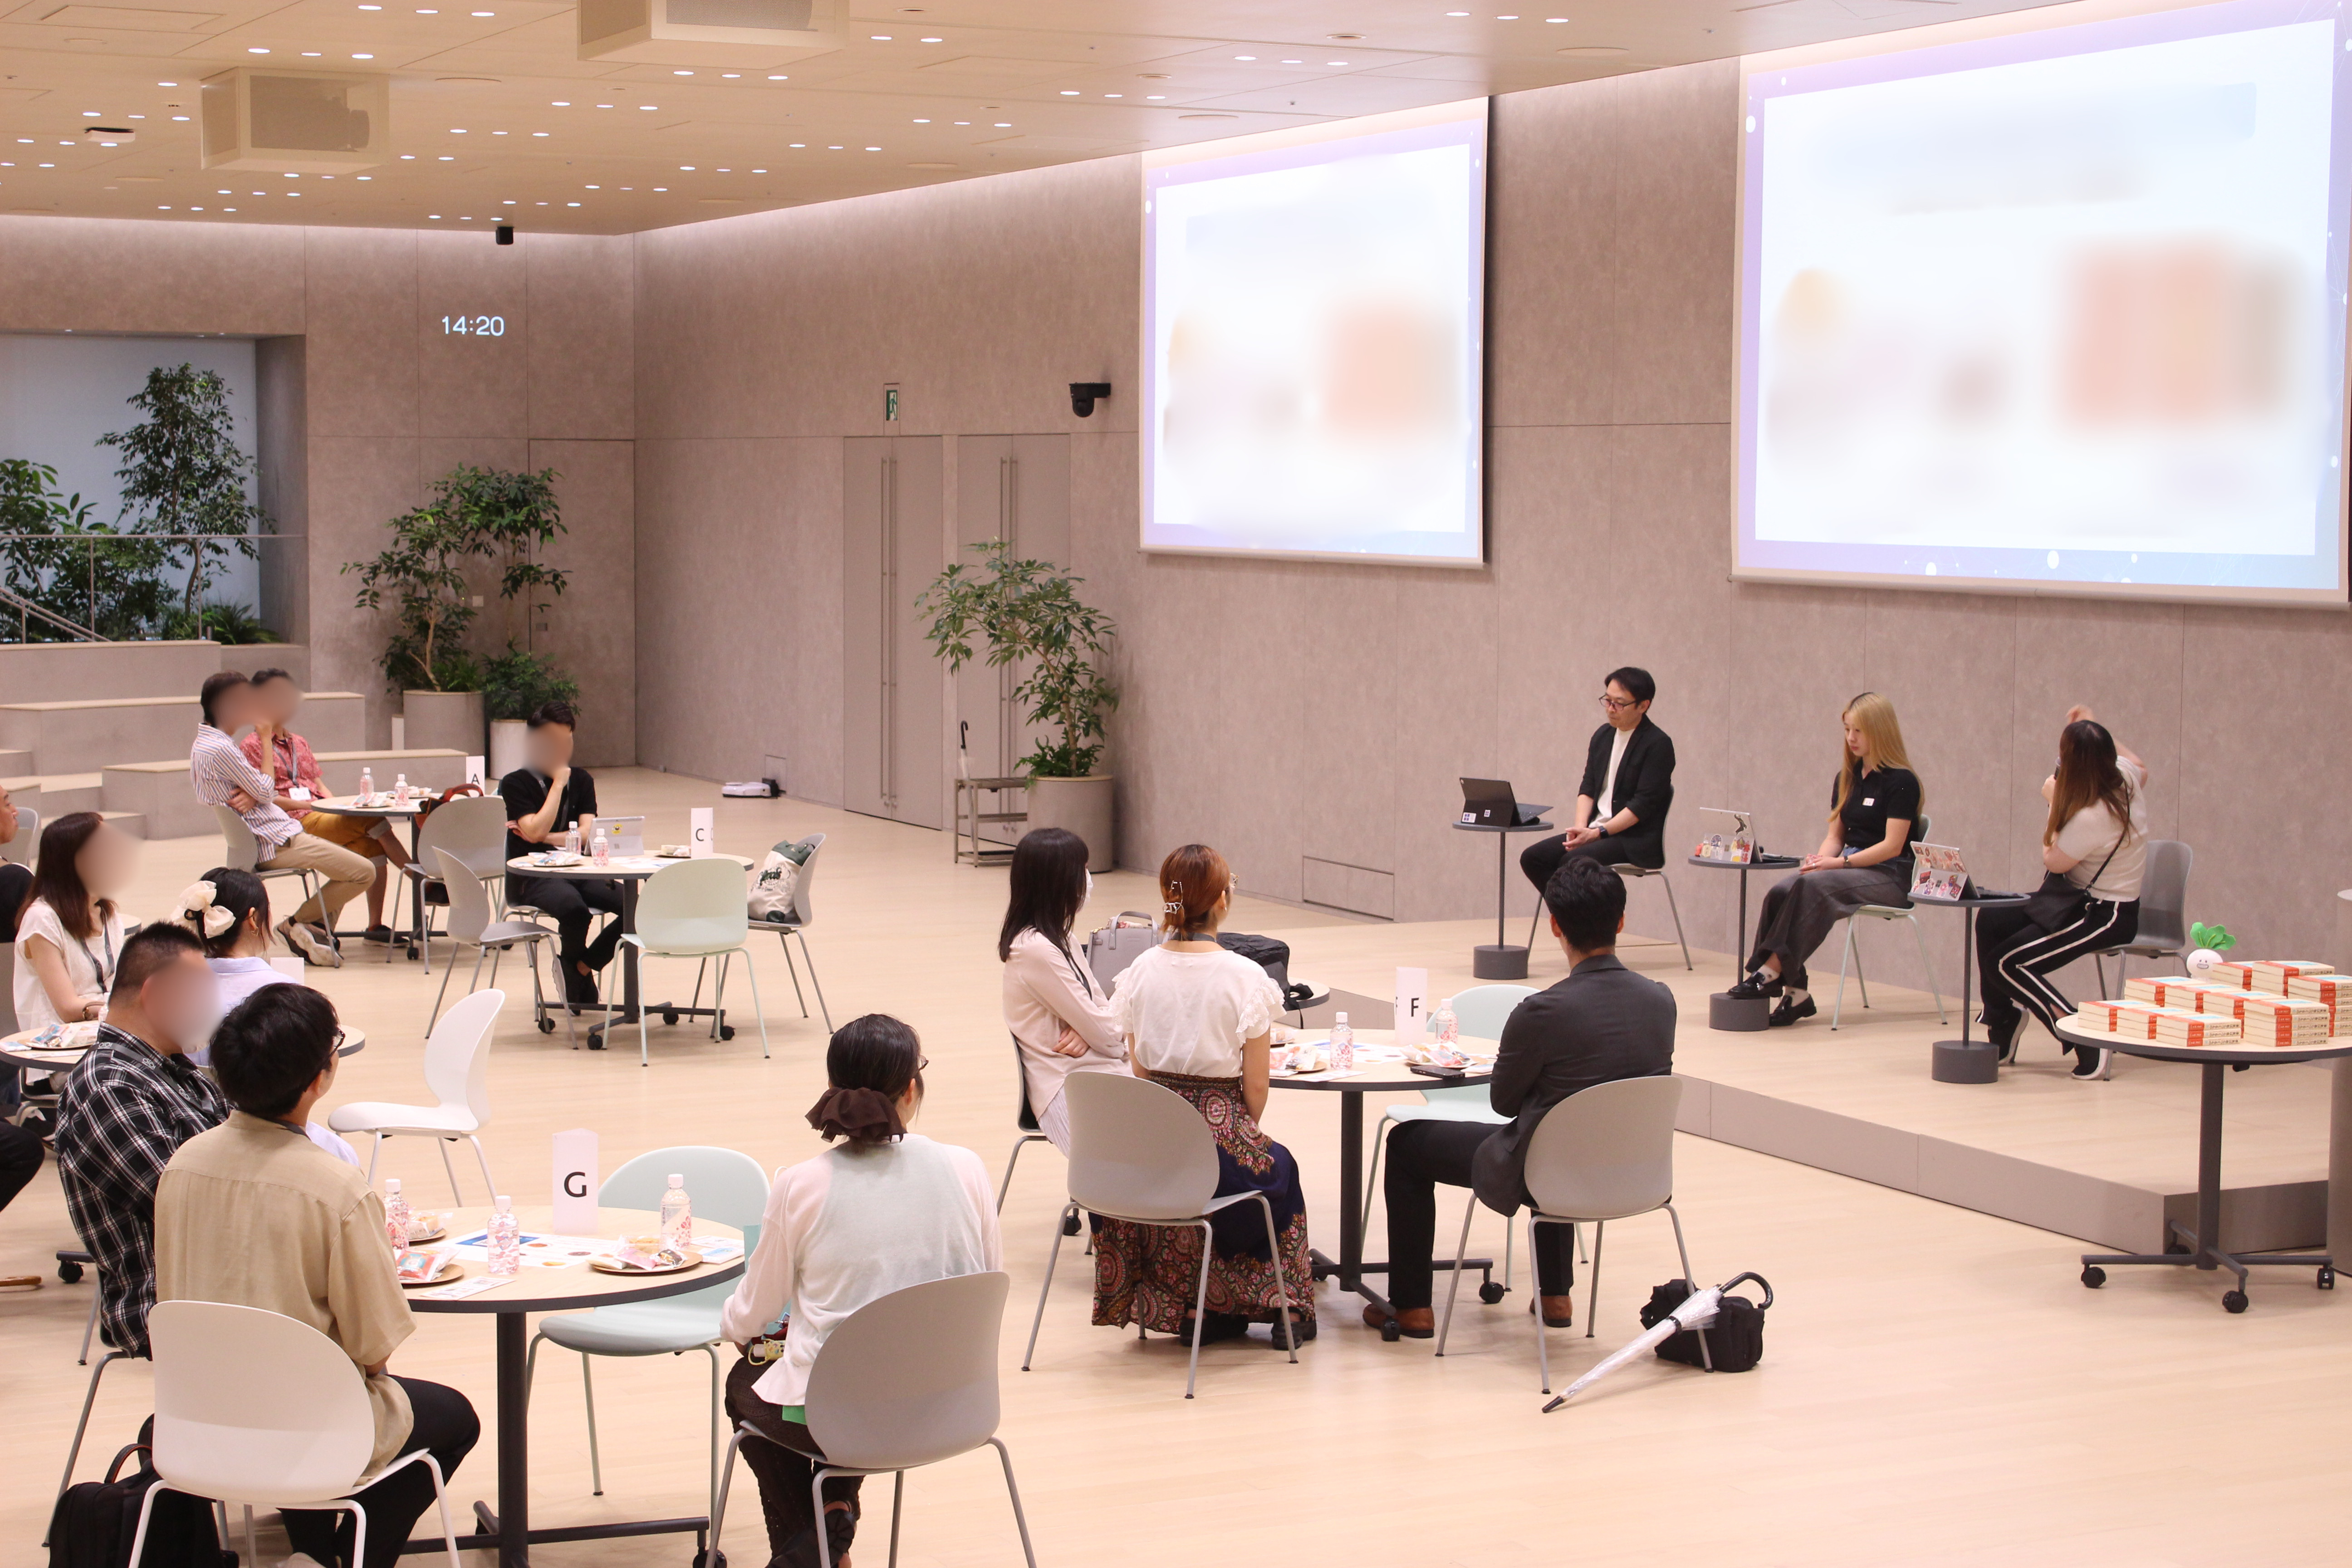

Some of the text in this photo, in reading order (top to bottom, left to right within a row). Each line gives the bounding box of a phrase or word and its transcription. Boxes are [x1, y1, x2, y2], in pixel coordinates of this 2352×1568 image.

[442, 316, 505, 336] 14:20
[471, 773, 480, 784] A
[696, 828, 704, 842] C
[1411, 997, 1419, 1017] F
[564, 1171, 587, 1198] G
